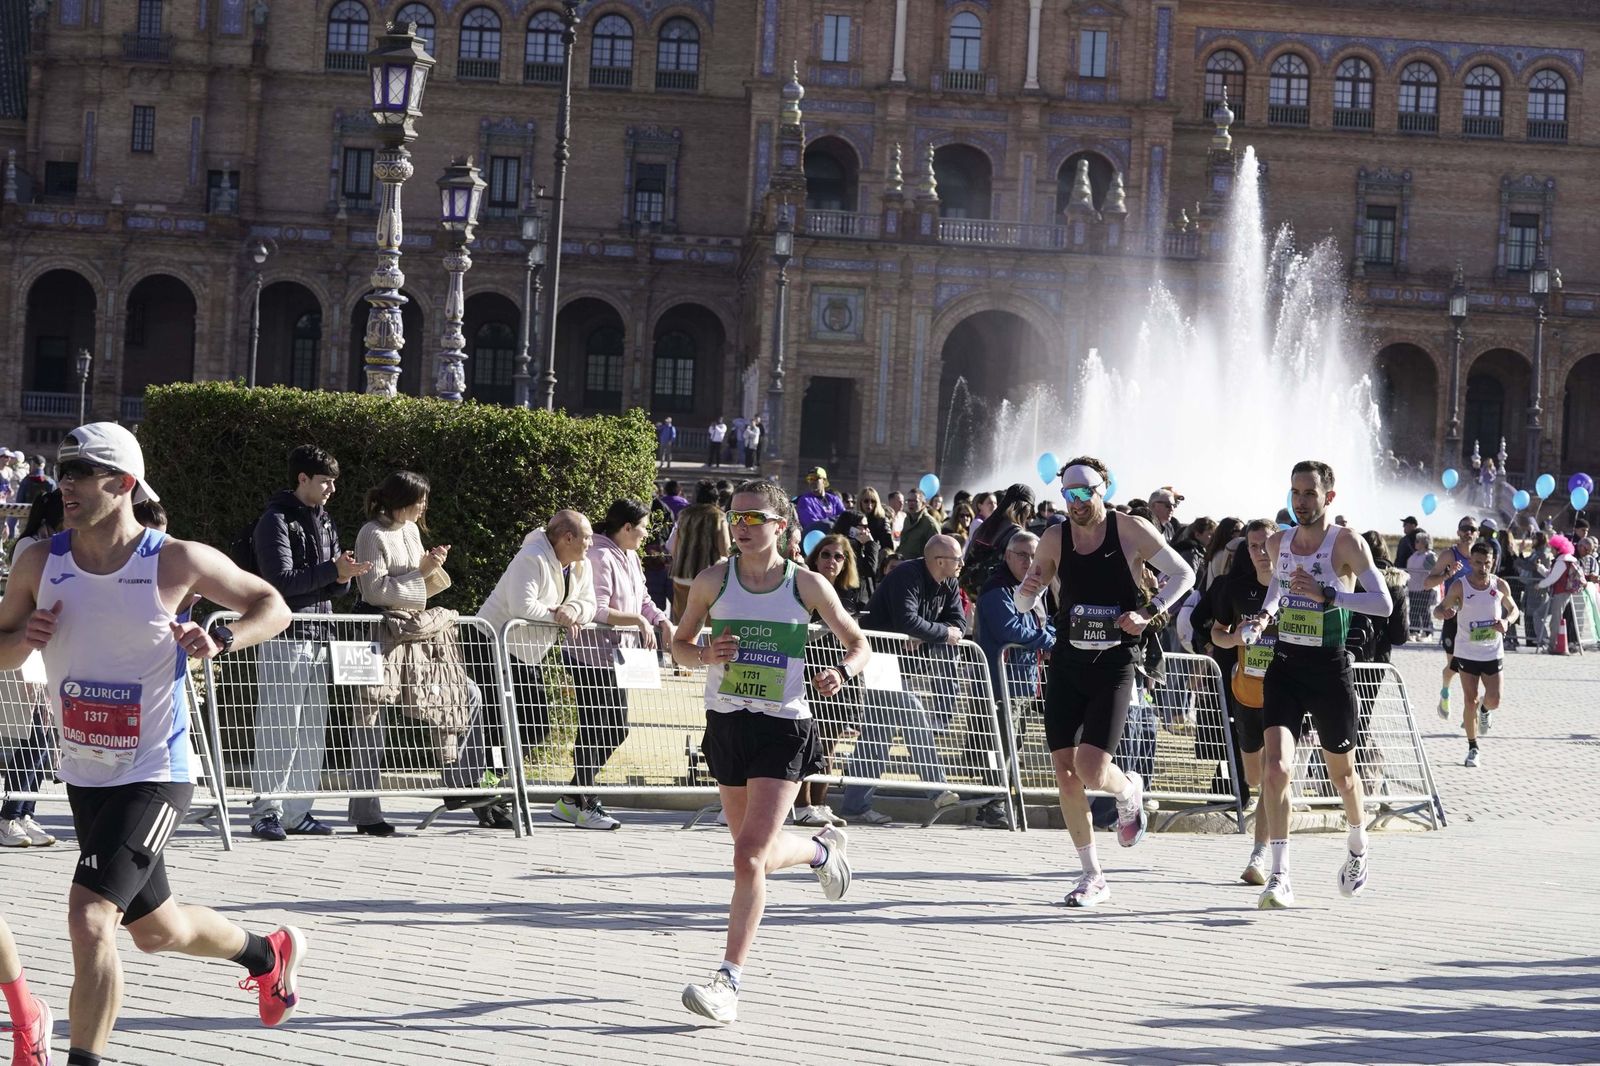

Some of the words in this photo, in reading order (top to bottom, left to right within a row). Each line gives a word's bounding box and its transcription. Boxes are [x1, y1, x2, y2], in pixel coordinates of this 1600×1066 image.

[1292, 600, 1318, 608] ZURICH
[739, 624, 772, 637] gala
[1083, 630, 1106, 640] HAIG
[739, 639, 778, 652] arriers
[345, 648, 371, 665] AMS
[743, 652, 780, 665] ZURICH
[742, 670, 760, 680] 1731
[83, 686, 131, 700] ZURICH
[735, 682, 767, 697] KATIE
[83, 711, 109, 723] 1317
[63, 726, 86, 743] TIAGO
[88, 733, 139, 748] GODINHO
